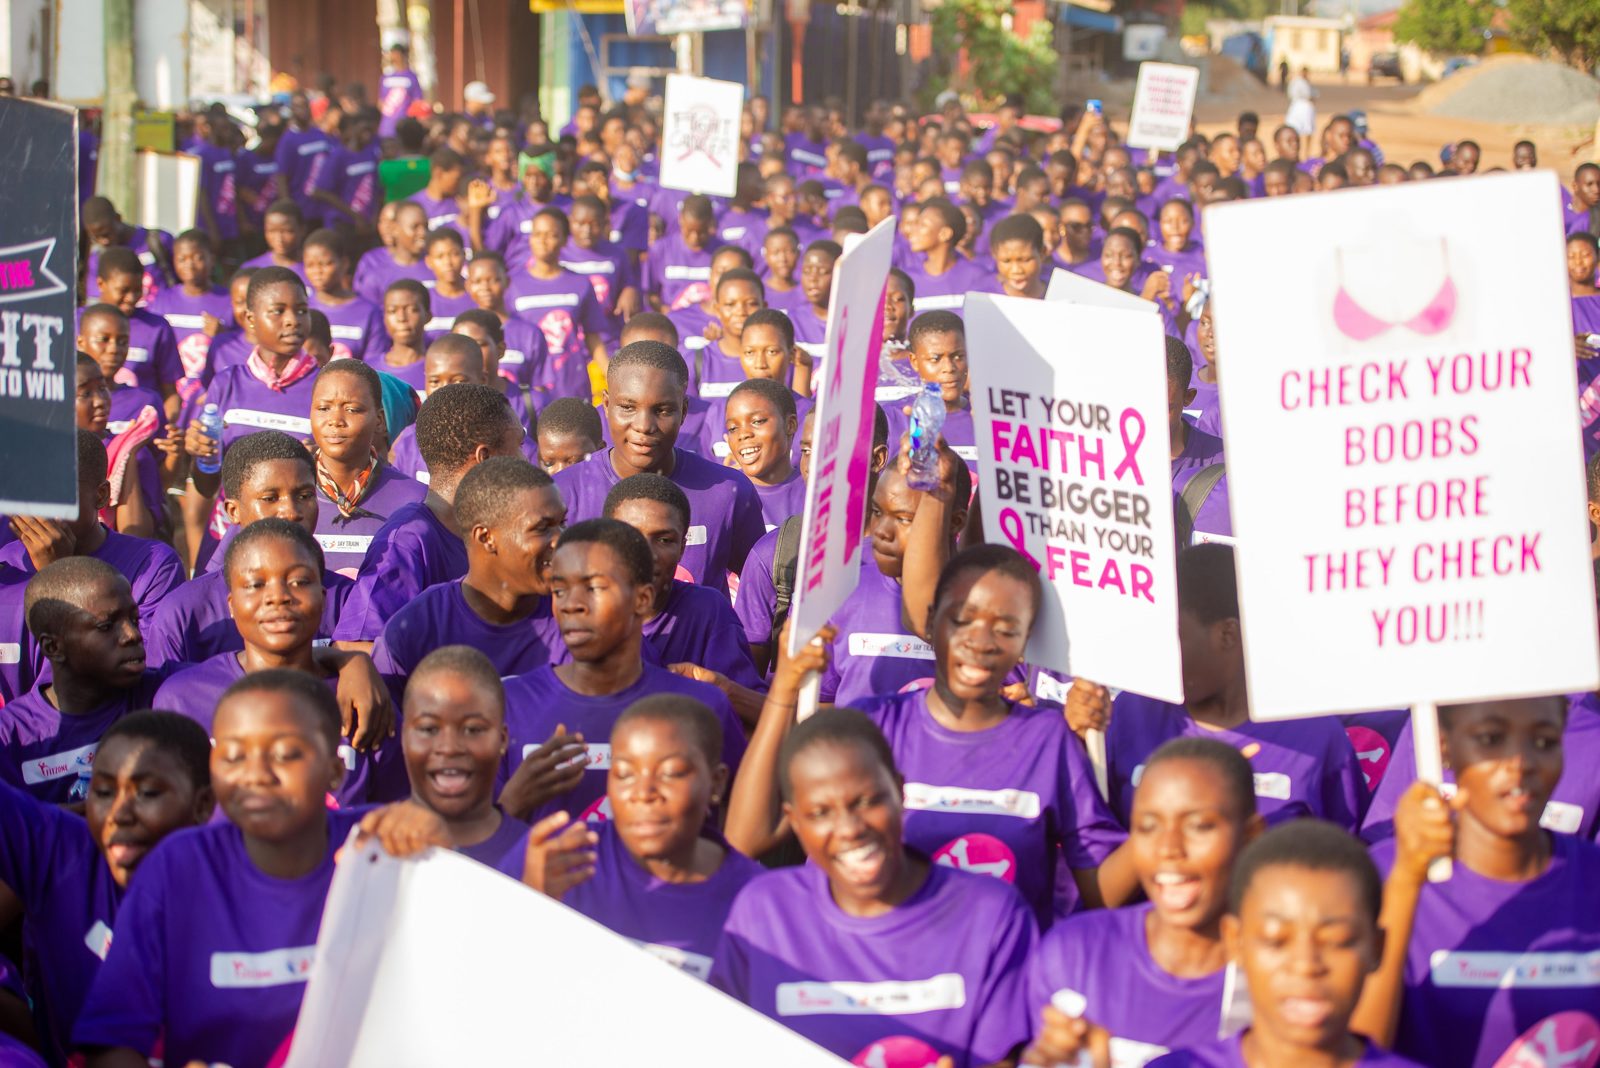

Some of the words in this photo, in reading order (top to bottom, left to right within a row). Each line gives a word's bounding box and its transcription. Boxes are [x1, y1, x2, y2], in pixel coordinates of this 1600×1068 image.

[0, 259, 35, 290] THE
[26, 370, 65, 402] WIN
[1280, 358, 1410, 411] CHECK
[1426, 347, 1533, 397] YOUR
[988, 387, 1030, 419] LET
[1040, 396, 1112, 433] YOUR
[991, 420, 1105, 481] FAITH
[1345, 414, 1479, 467] BOOBS
[995, 468, 1031, 505] BE
[1040, 477, 1152, 529] BIGGER
[1345, 475, 1490, 528] BEFORE
[1025, 512, 1087, 545] THAN
[1093, 526, 1154, 559] YOUR
[1046, 545, 1155, 604] FEAR
[1303, 547, 1395, 594] THEY
[1413, 532, 1542, 583] CHECK
[1372, 599, 1484, 648] YOU!!!
